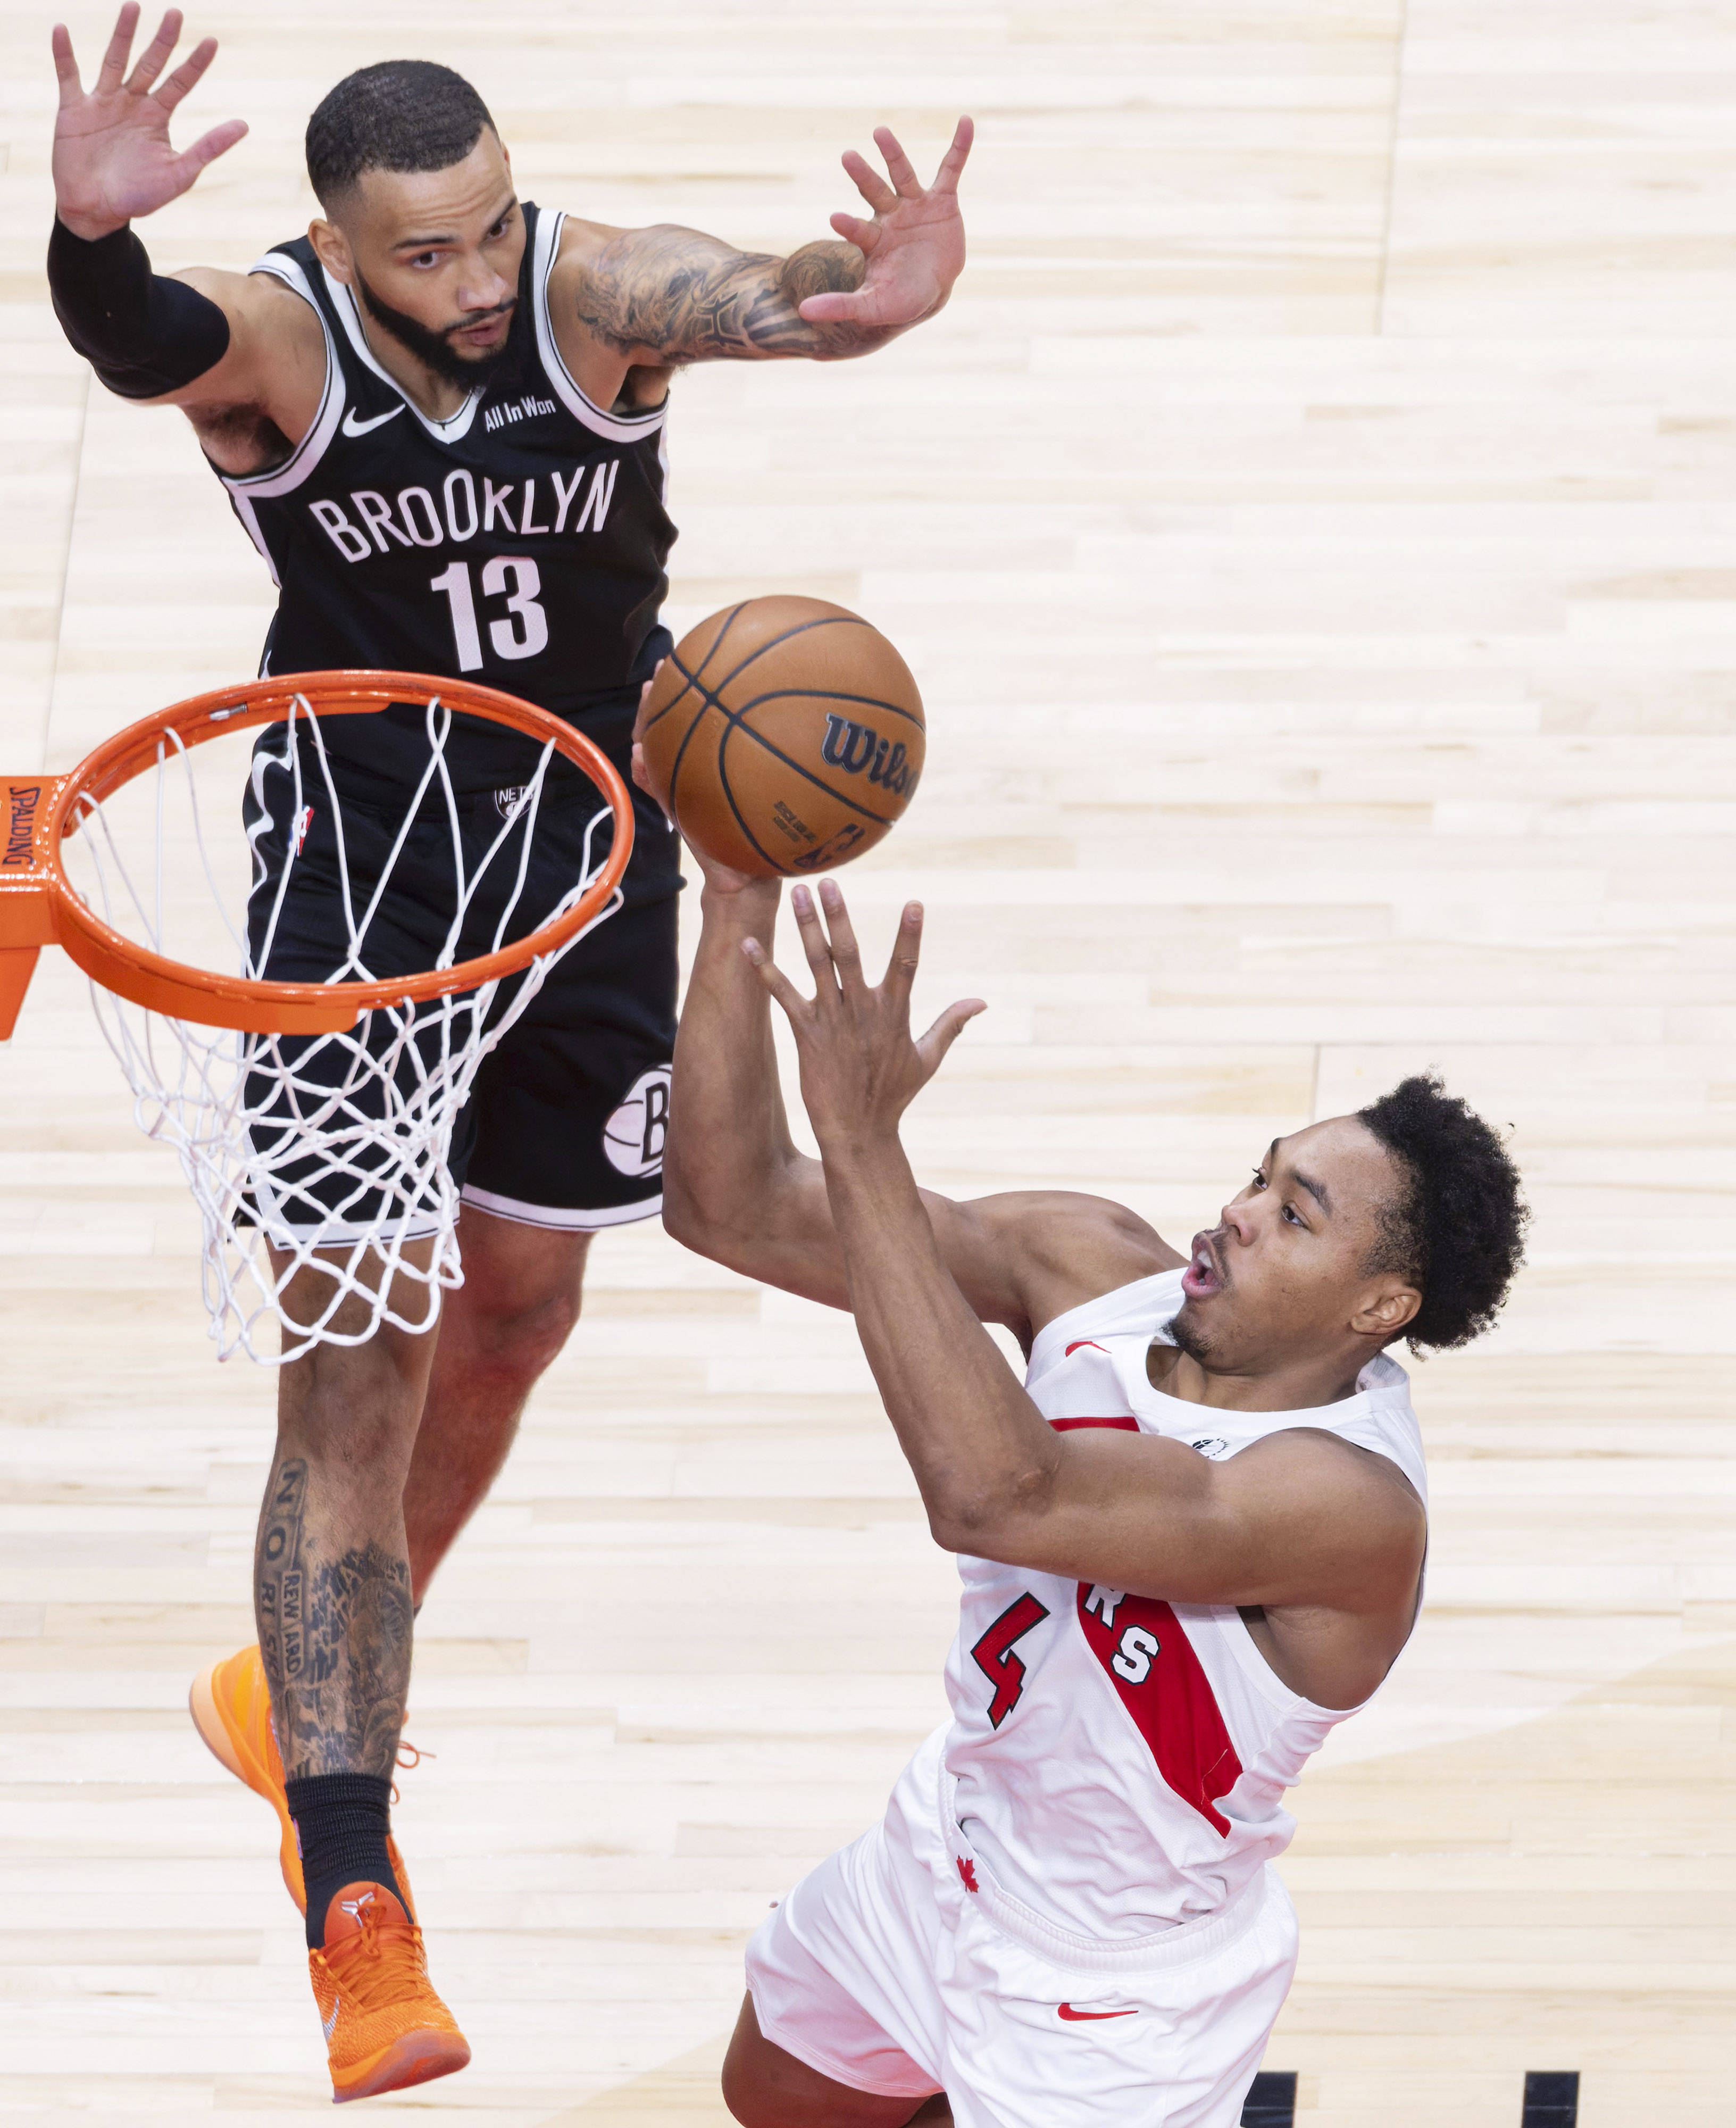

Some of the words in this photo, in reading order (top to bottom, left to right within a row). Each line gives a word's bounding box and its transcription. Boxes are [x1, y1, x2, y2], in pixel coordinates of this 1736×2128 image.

[485, 405, 504, 433] All
[503, 402, 523, 423] In
[520, 395, 556, 418] Won
[309, 460, 620, 563] BROOKLYN
[430, 555, 549, 672] 13
[2, 786, 41, 865] SPALDING
[641, 1082, 670, 1164] B
[283, 1573, 302, 1674] REWARD
